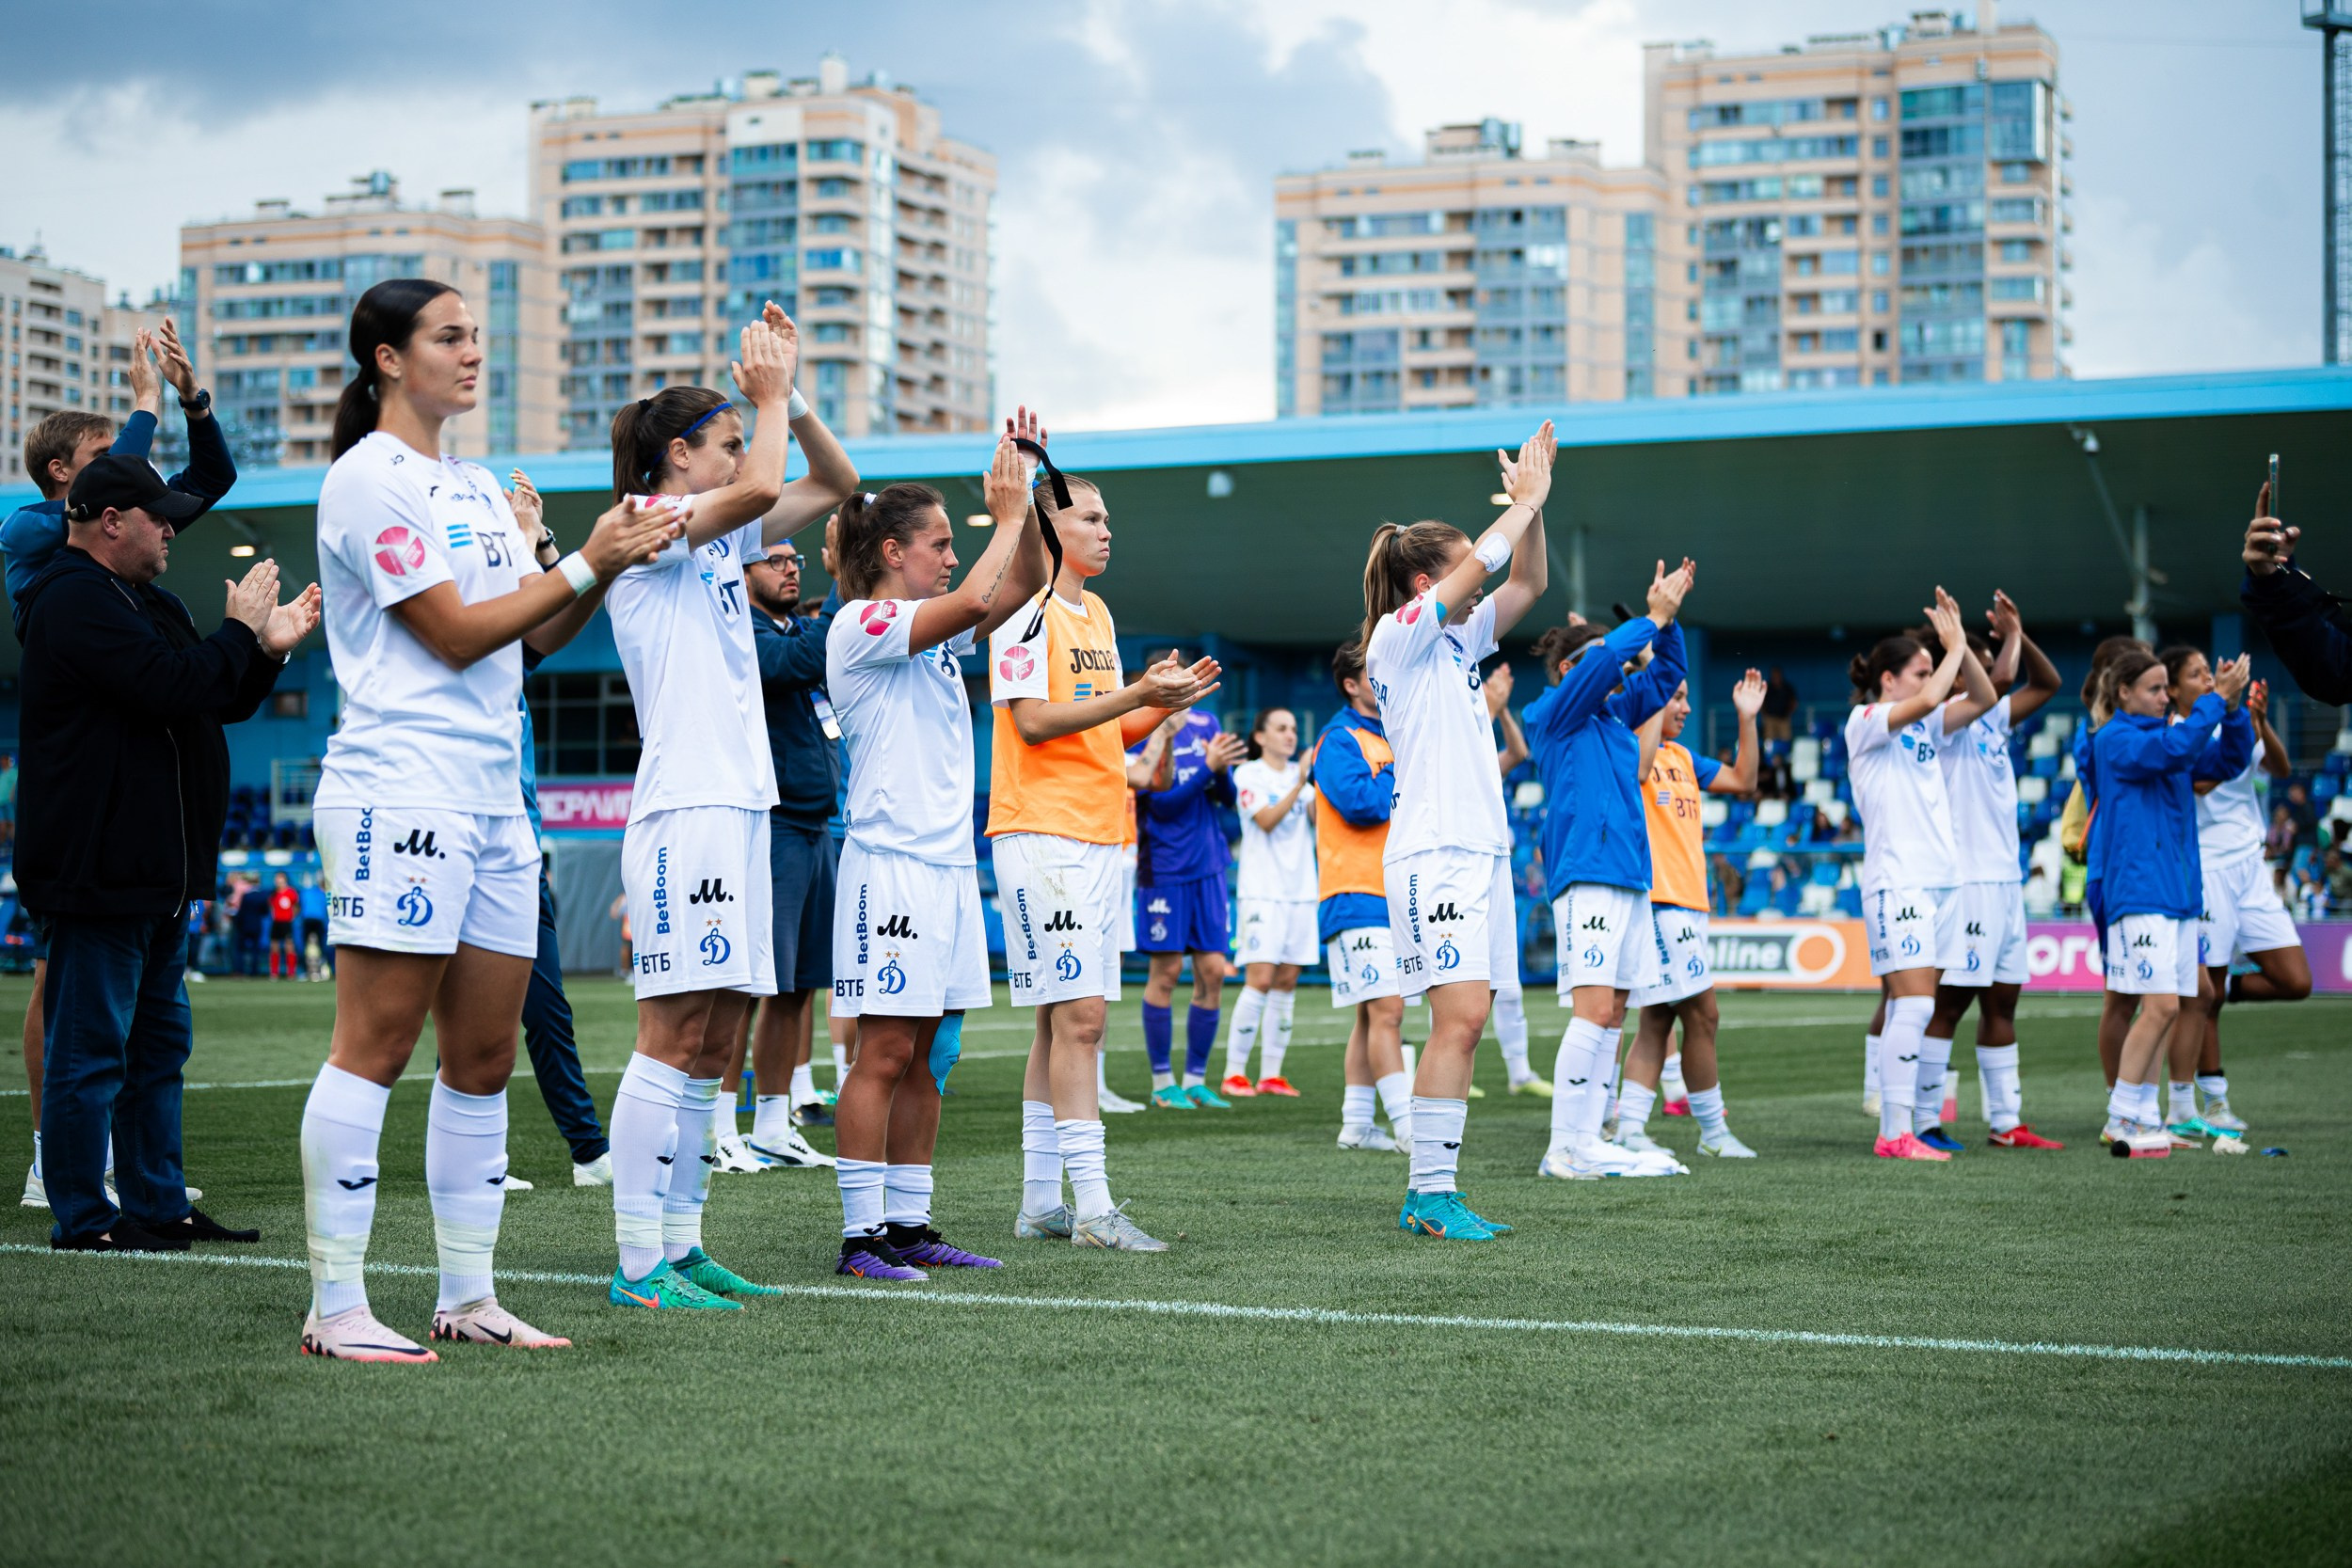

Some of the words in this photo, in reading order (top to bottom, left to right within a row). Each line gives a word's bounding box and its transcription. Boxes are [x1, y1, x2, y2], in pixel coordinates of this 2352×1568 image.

[356, 808, 373, 881] BetBoo
[332, 896, 365, 918] ВТБ
[653, 847, 671, 935] BetBoom
[1408, 874, 1422, 943] BetBoom
[856, 883, 868, 965] BetBoom
[1016, 888, 1037, 960] BetBoom
[641, 952, 671, 974] ВТБ
[1013, 972, 1033, 989] ВТБ
[1403, 956, 1423, 975] ВТБ
[835, 978, 865, 997] ВТБ
